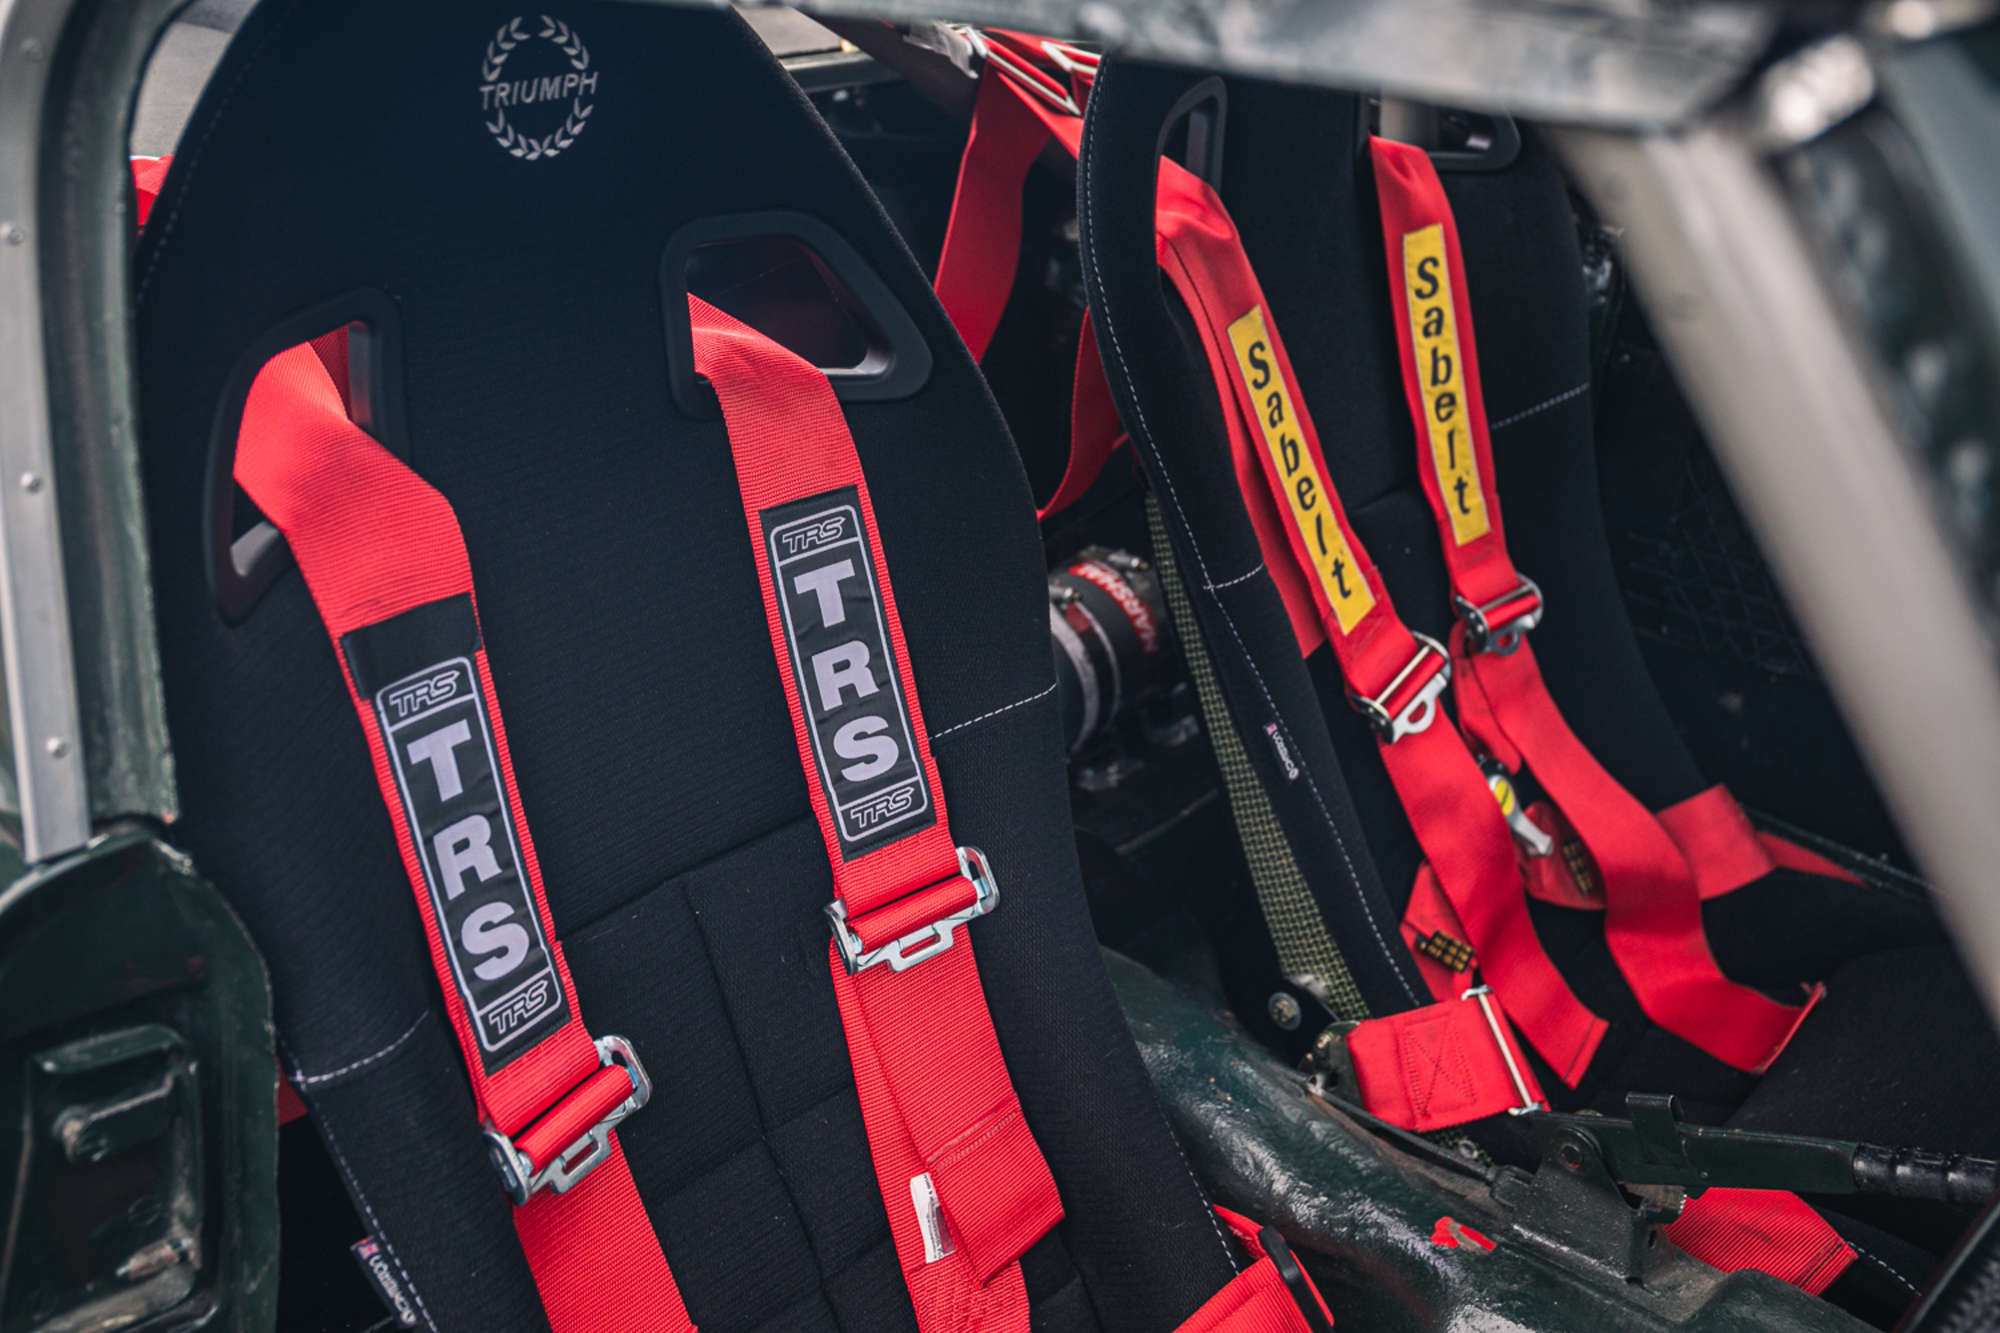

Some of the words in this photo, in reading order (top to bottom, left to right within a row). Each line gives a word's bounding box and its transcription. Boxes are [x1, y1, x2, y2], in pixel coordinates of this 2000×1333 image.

[479, 72, 598, 110] TRIUMPH
[1414, 257, 1470, 515] Sabelt
[1248, 340, 1351, 599] Sabelt
[782, 516, 846, 554] TRS
[389, 670, 460, 717] TRS
[793, 558, 899, 782] TRS
[850, 786, 915, 829] TRS
[406, 719, 530, 980] TRS
[488, 980, 548, 1034] TRS
